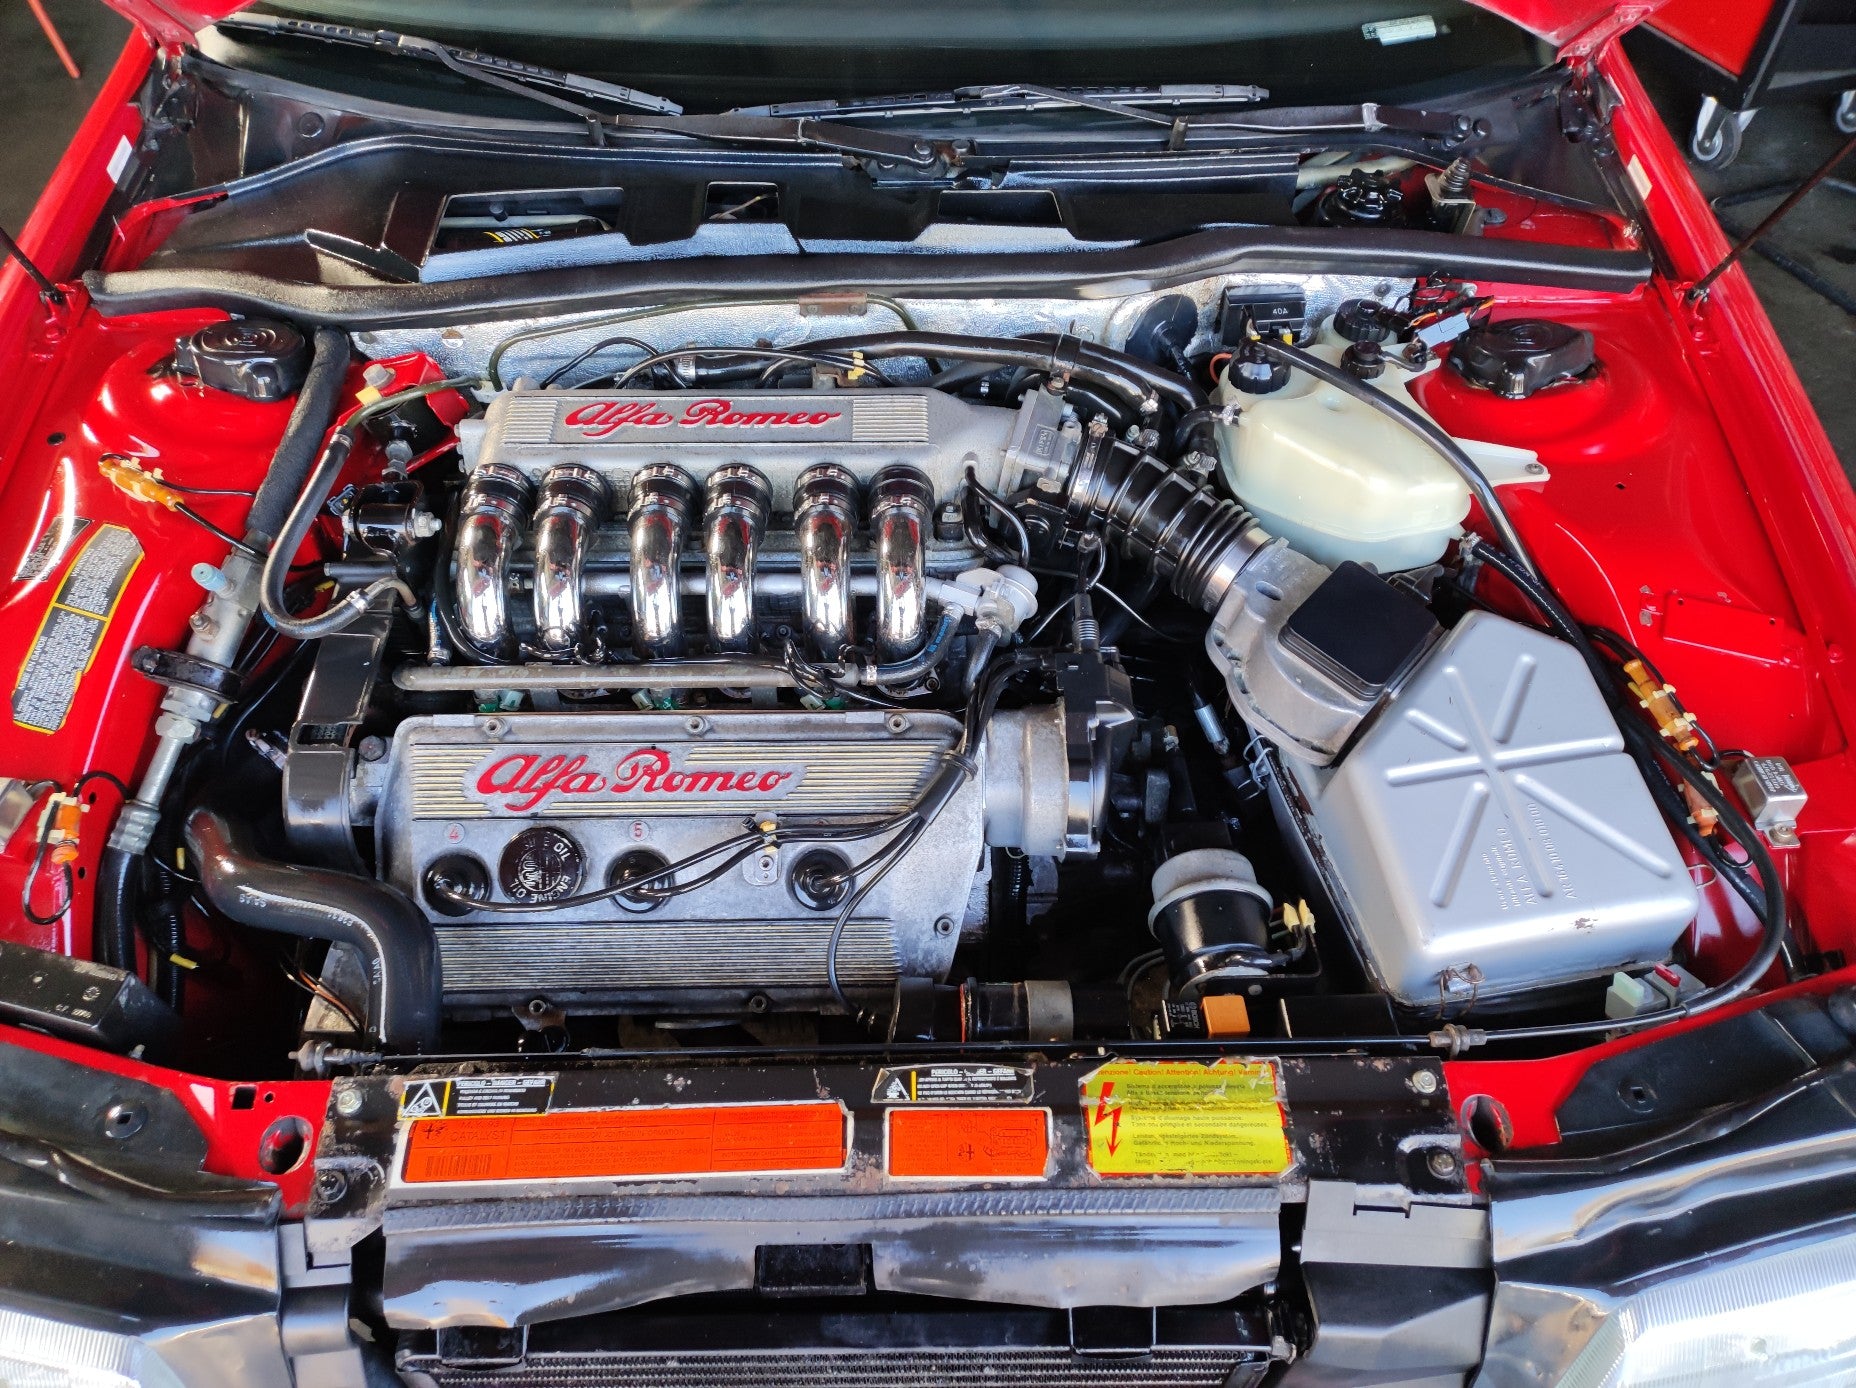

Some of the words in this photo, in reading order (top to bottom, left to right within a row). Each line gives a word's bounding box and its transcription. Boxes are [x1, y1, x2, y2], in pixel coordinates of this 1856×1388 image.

[1272, 307, 1288, 315] 40A
[564, 401, 674, 438] Alfa
[678, 398, 842, 428] Romeo
[476, 753, 607, 812] Alfa
[610, 749, 793, 794] Romeo
[448, 826, 459, 840] 4
[633, 824, 643, 838] 5
[553, 842, 571, 862] OIL
[509, 878, 527, 898] OIL
[450, 1130, 506, 1142] CATALYST
